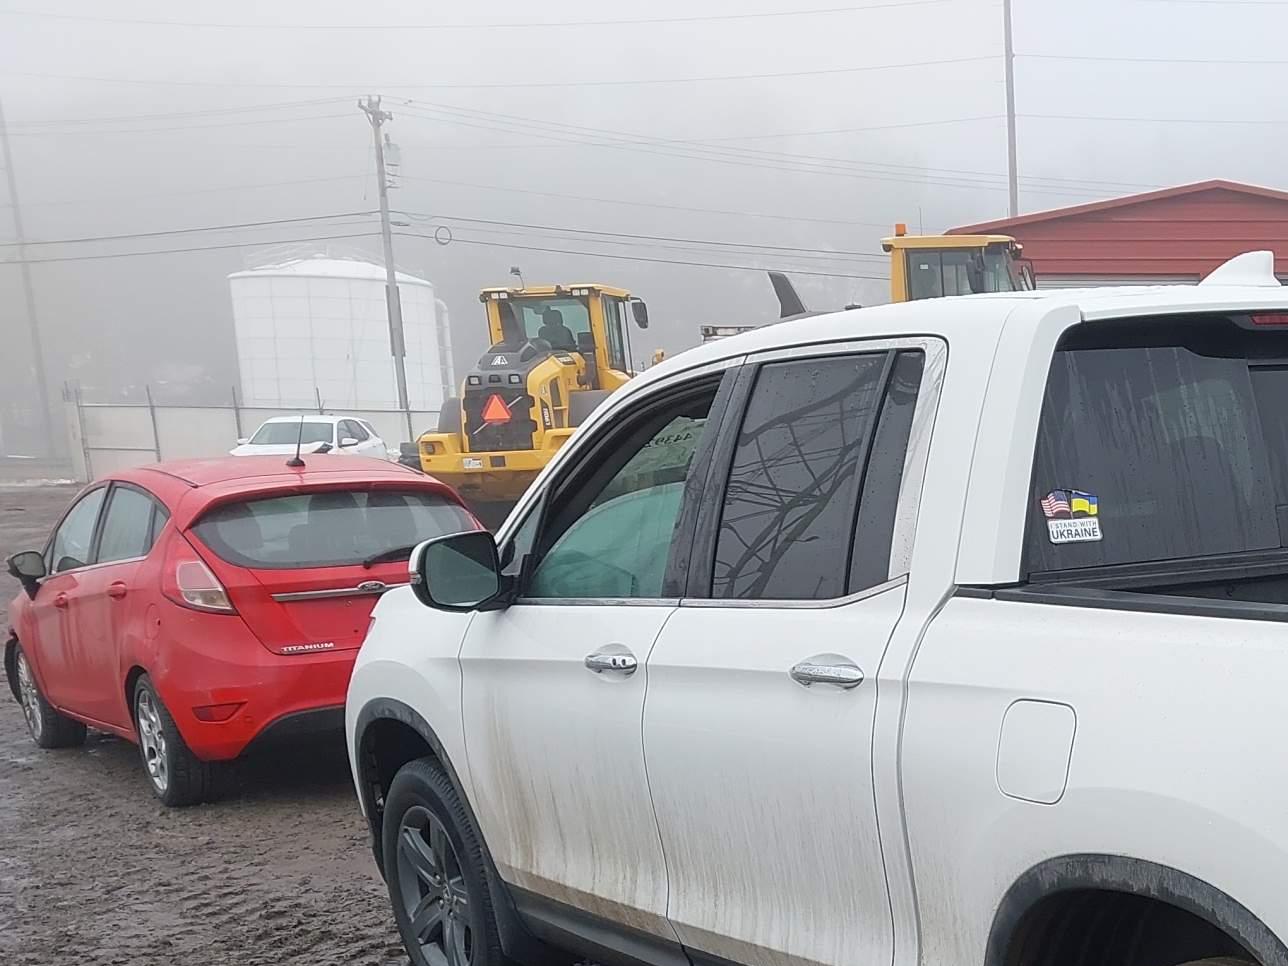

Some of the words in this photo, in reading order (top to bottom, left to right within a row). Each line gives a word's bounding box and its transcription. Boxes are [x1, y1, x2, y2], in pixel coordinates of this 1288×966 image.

[1080, 520, 1097, 528] WITH
[1051, 527, 1099, 540] UKRAINE
[281, 642, 334, 652] TITANIUM
